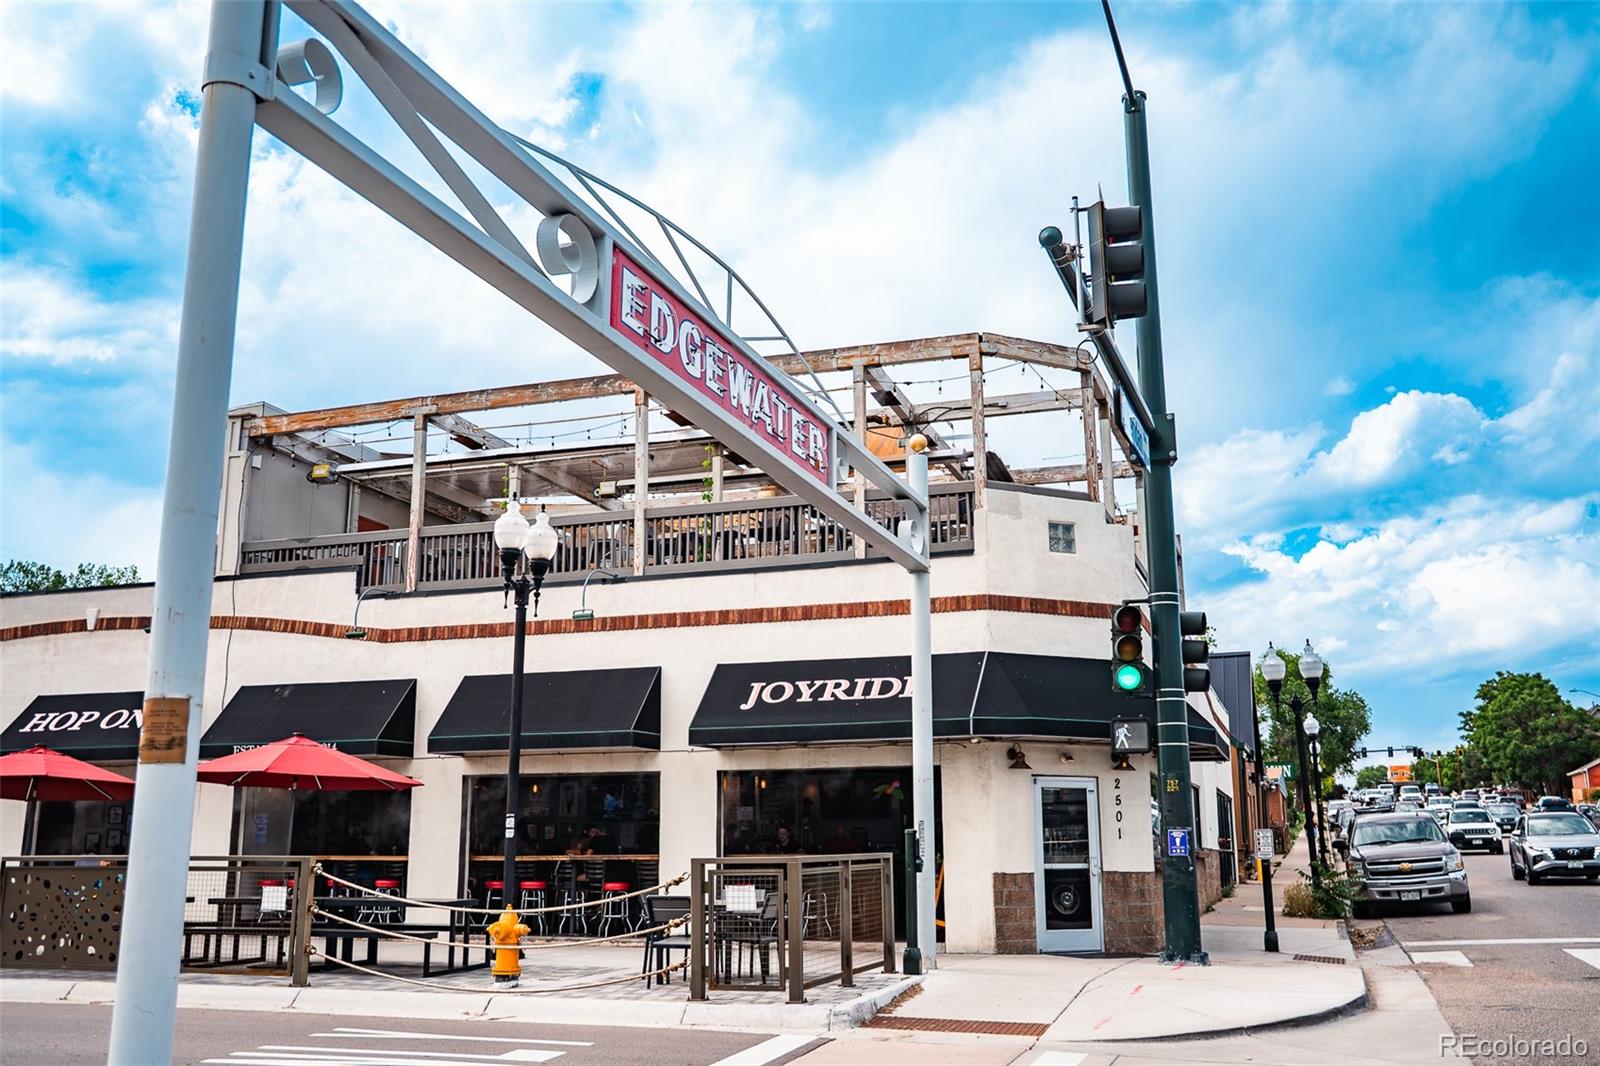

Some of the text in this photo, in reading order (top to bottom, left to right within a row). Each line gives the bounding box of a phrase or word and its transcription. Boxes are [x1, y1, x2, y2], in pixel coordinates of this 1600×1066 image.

[620, 264, 828, 475] EDGEWATER
[18, 710, 101, 733] HOP
[1114, 777, 1123, 840] 2501
